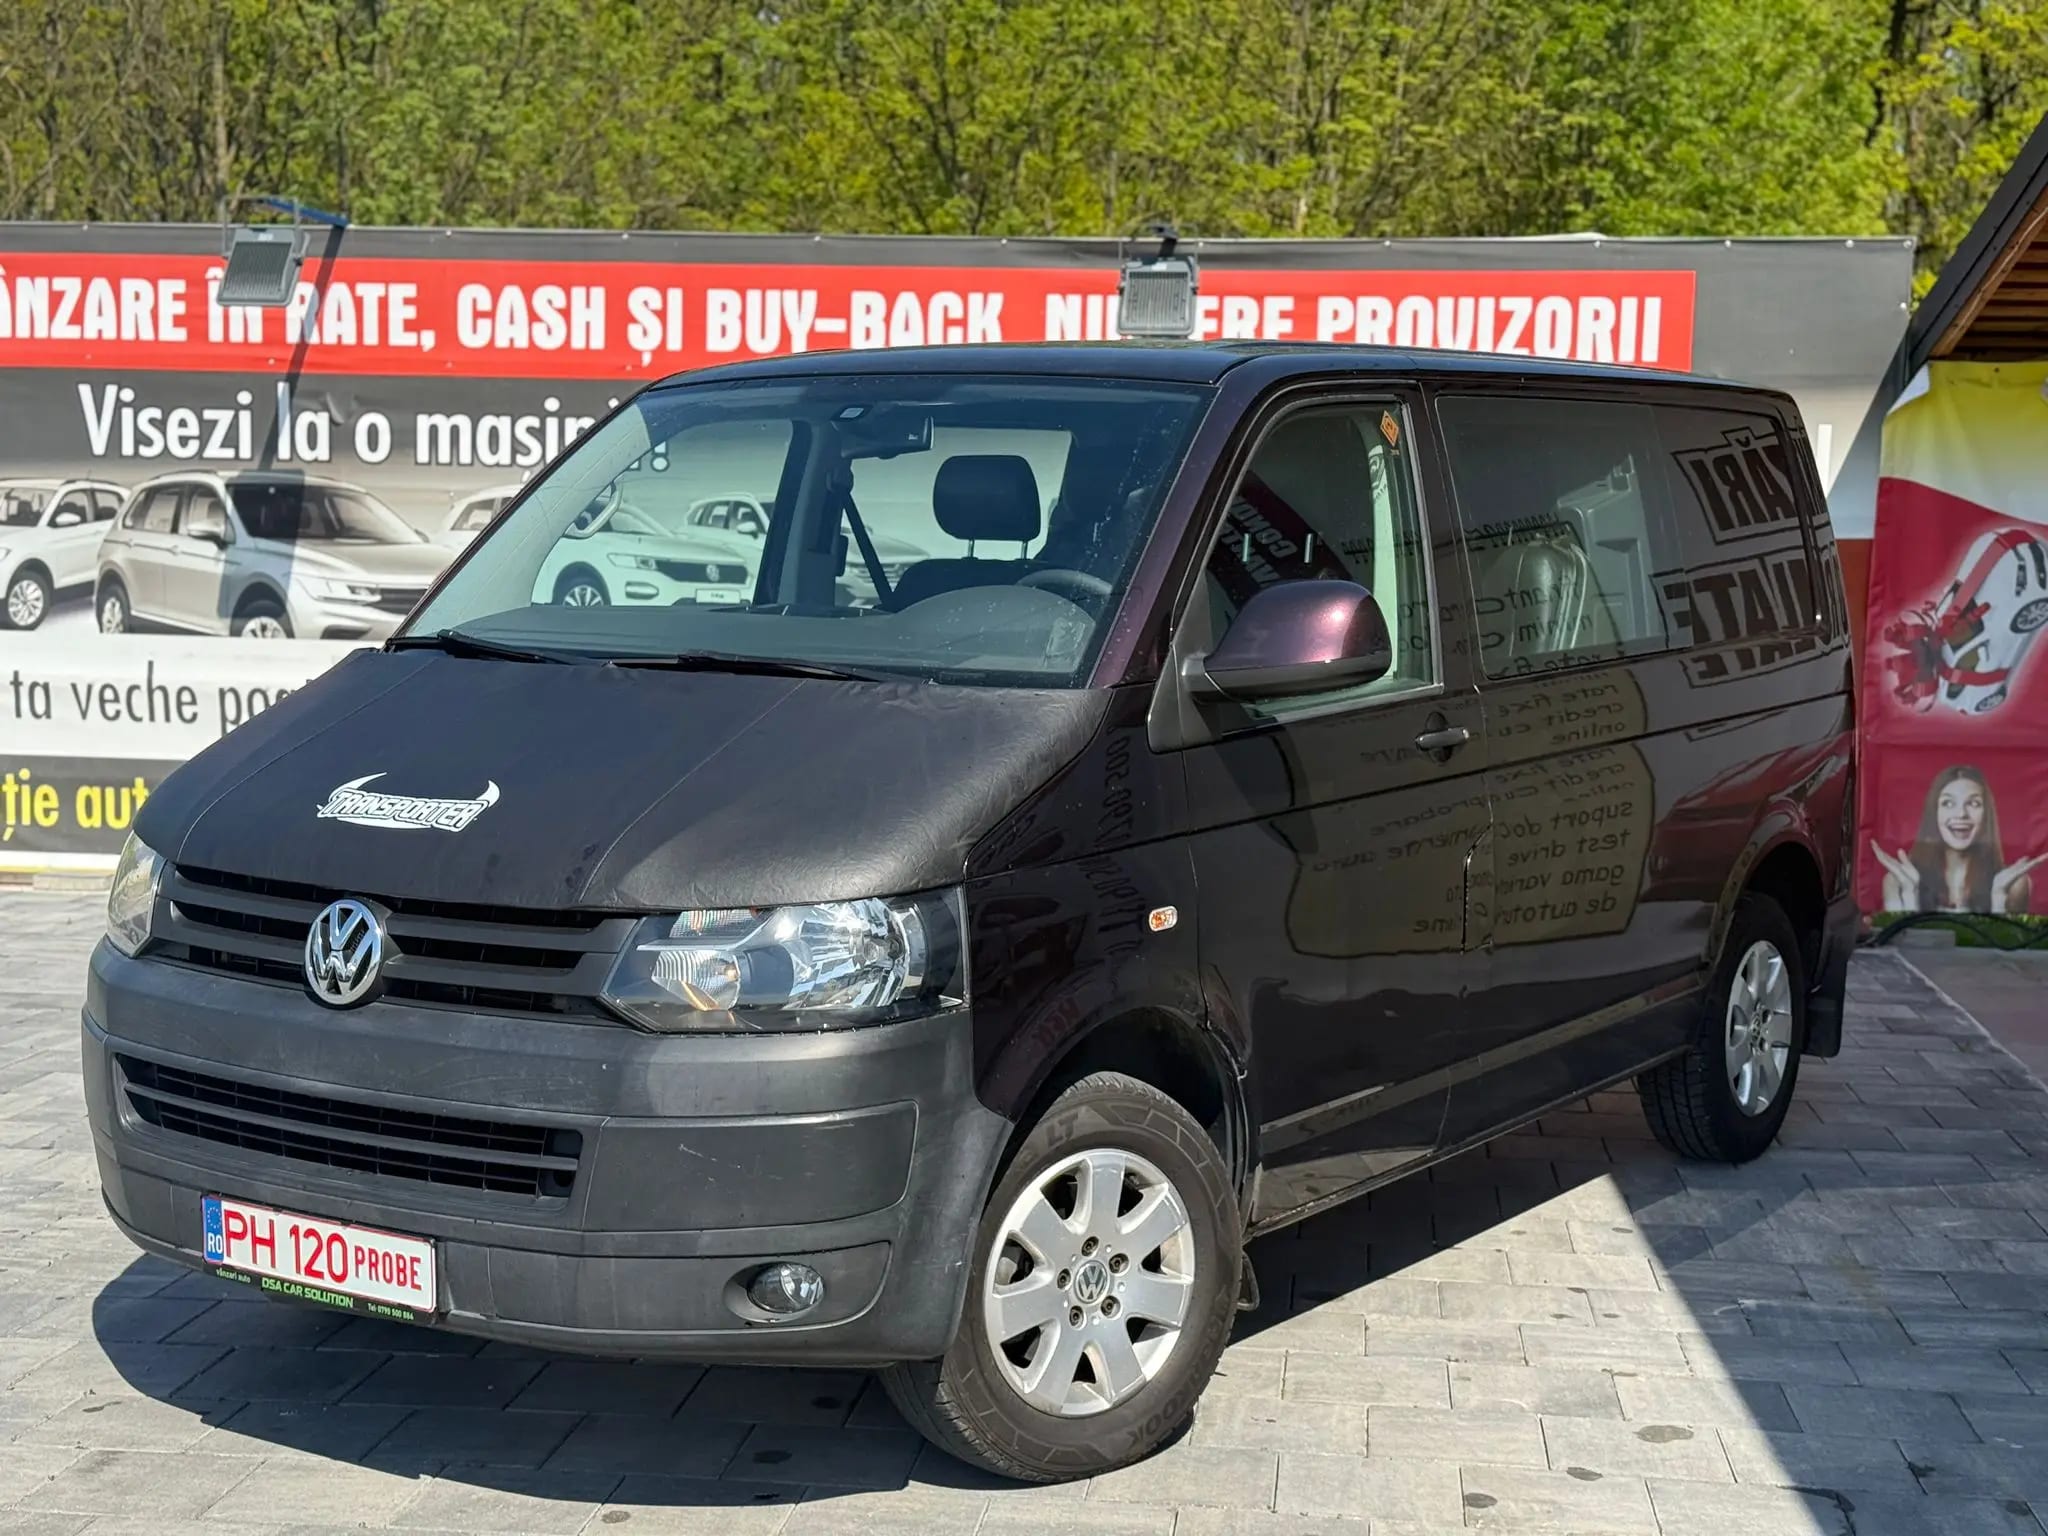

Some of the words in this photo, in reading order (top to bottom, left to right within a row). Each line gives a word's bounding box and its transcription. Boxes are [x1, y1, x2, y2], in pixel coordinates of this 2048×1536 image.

[285, 281, 436, 352] RATE,
[456, 283, 606, 351] CASH
[627, 286, 684, 367] ȘI
[706, 288, 1005, 354] BUY-BACK
[1046, 293, 1295, 342] NUERE
[1317, 296, 1662, 364] PROVIZORII
[78, 383, 253, 460] Visezi
[277, 381, 331, 464] la
[354, 412, 392, 464] o
[10, 670, 52, 719] ta
[71, 660, 198, 724] veche
[76, 776, 150, 830] aut
[322, 788, 486, 830] TRANSPORTER
[207, 1232, 223, 1255] RO
[223, 1209, 277, 1269] PH
[289, 1223, 349, 1284] 120
[354, 1244, 423, 1291] PROBE
[261, 1276, 282, 1293] DSA
[283, 1282, 304, 1298] CAR
[304, 1287, 354, 1309] SOLUTION
